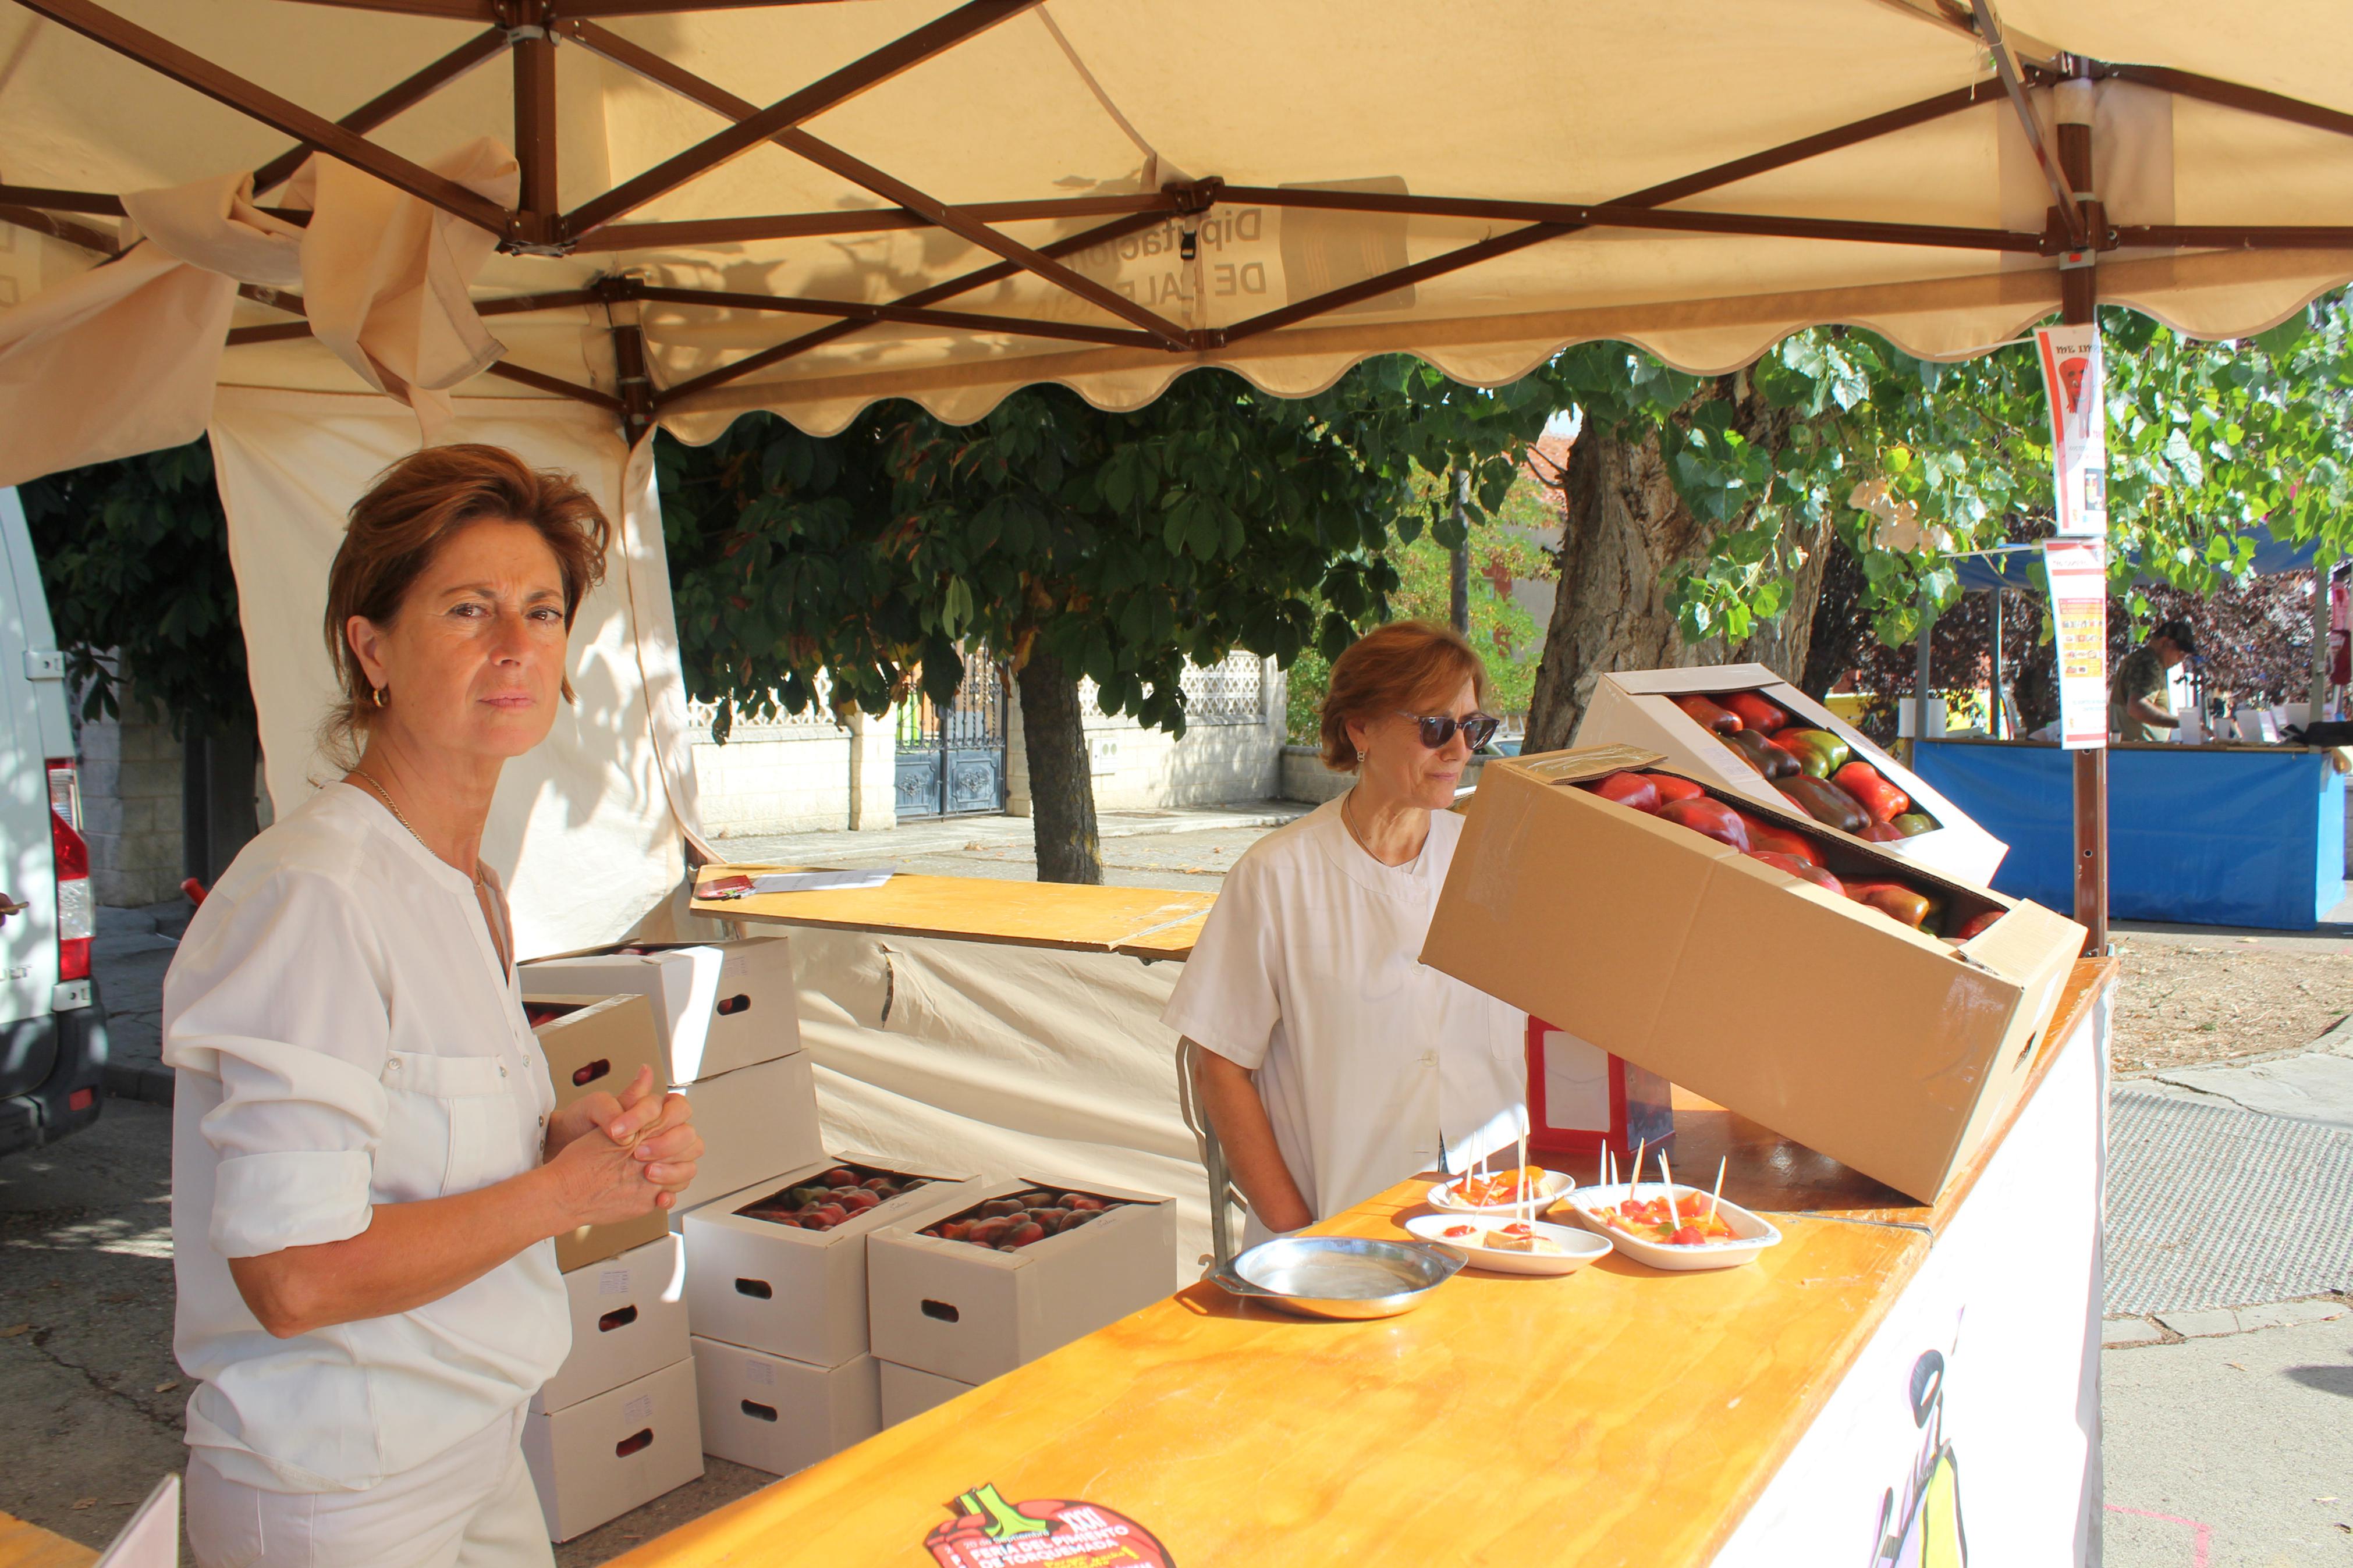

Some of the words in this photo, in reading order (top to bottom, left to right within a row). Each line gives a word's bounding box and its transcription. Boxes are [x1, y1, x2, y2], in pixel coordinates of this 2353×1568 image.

[970, 1543, 1020, 1561] FERIA
[1018, 1539, 1053, 1552] DEL
[1051, 1525, 1129, 1545] PIMIENTO
[978, 1557, 1005, 1568] DE
[1003, 1539, 1119, 1566] TORQUEMADA
[979, 1537, 992, 1546] de
